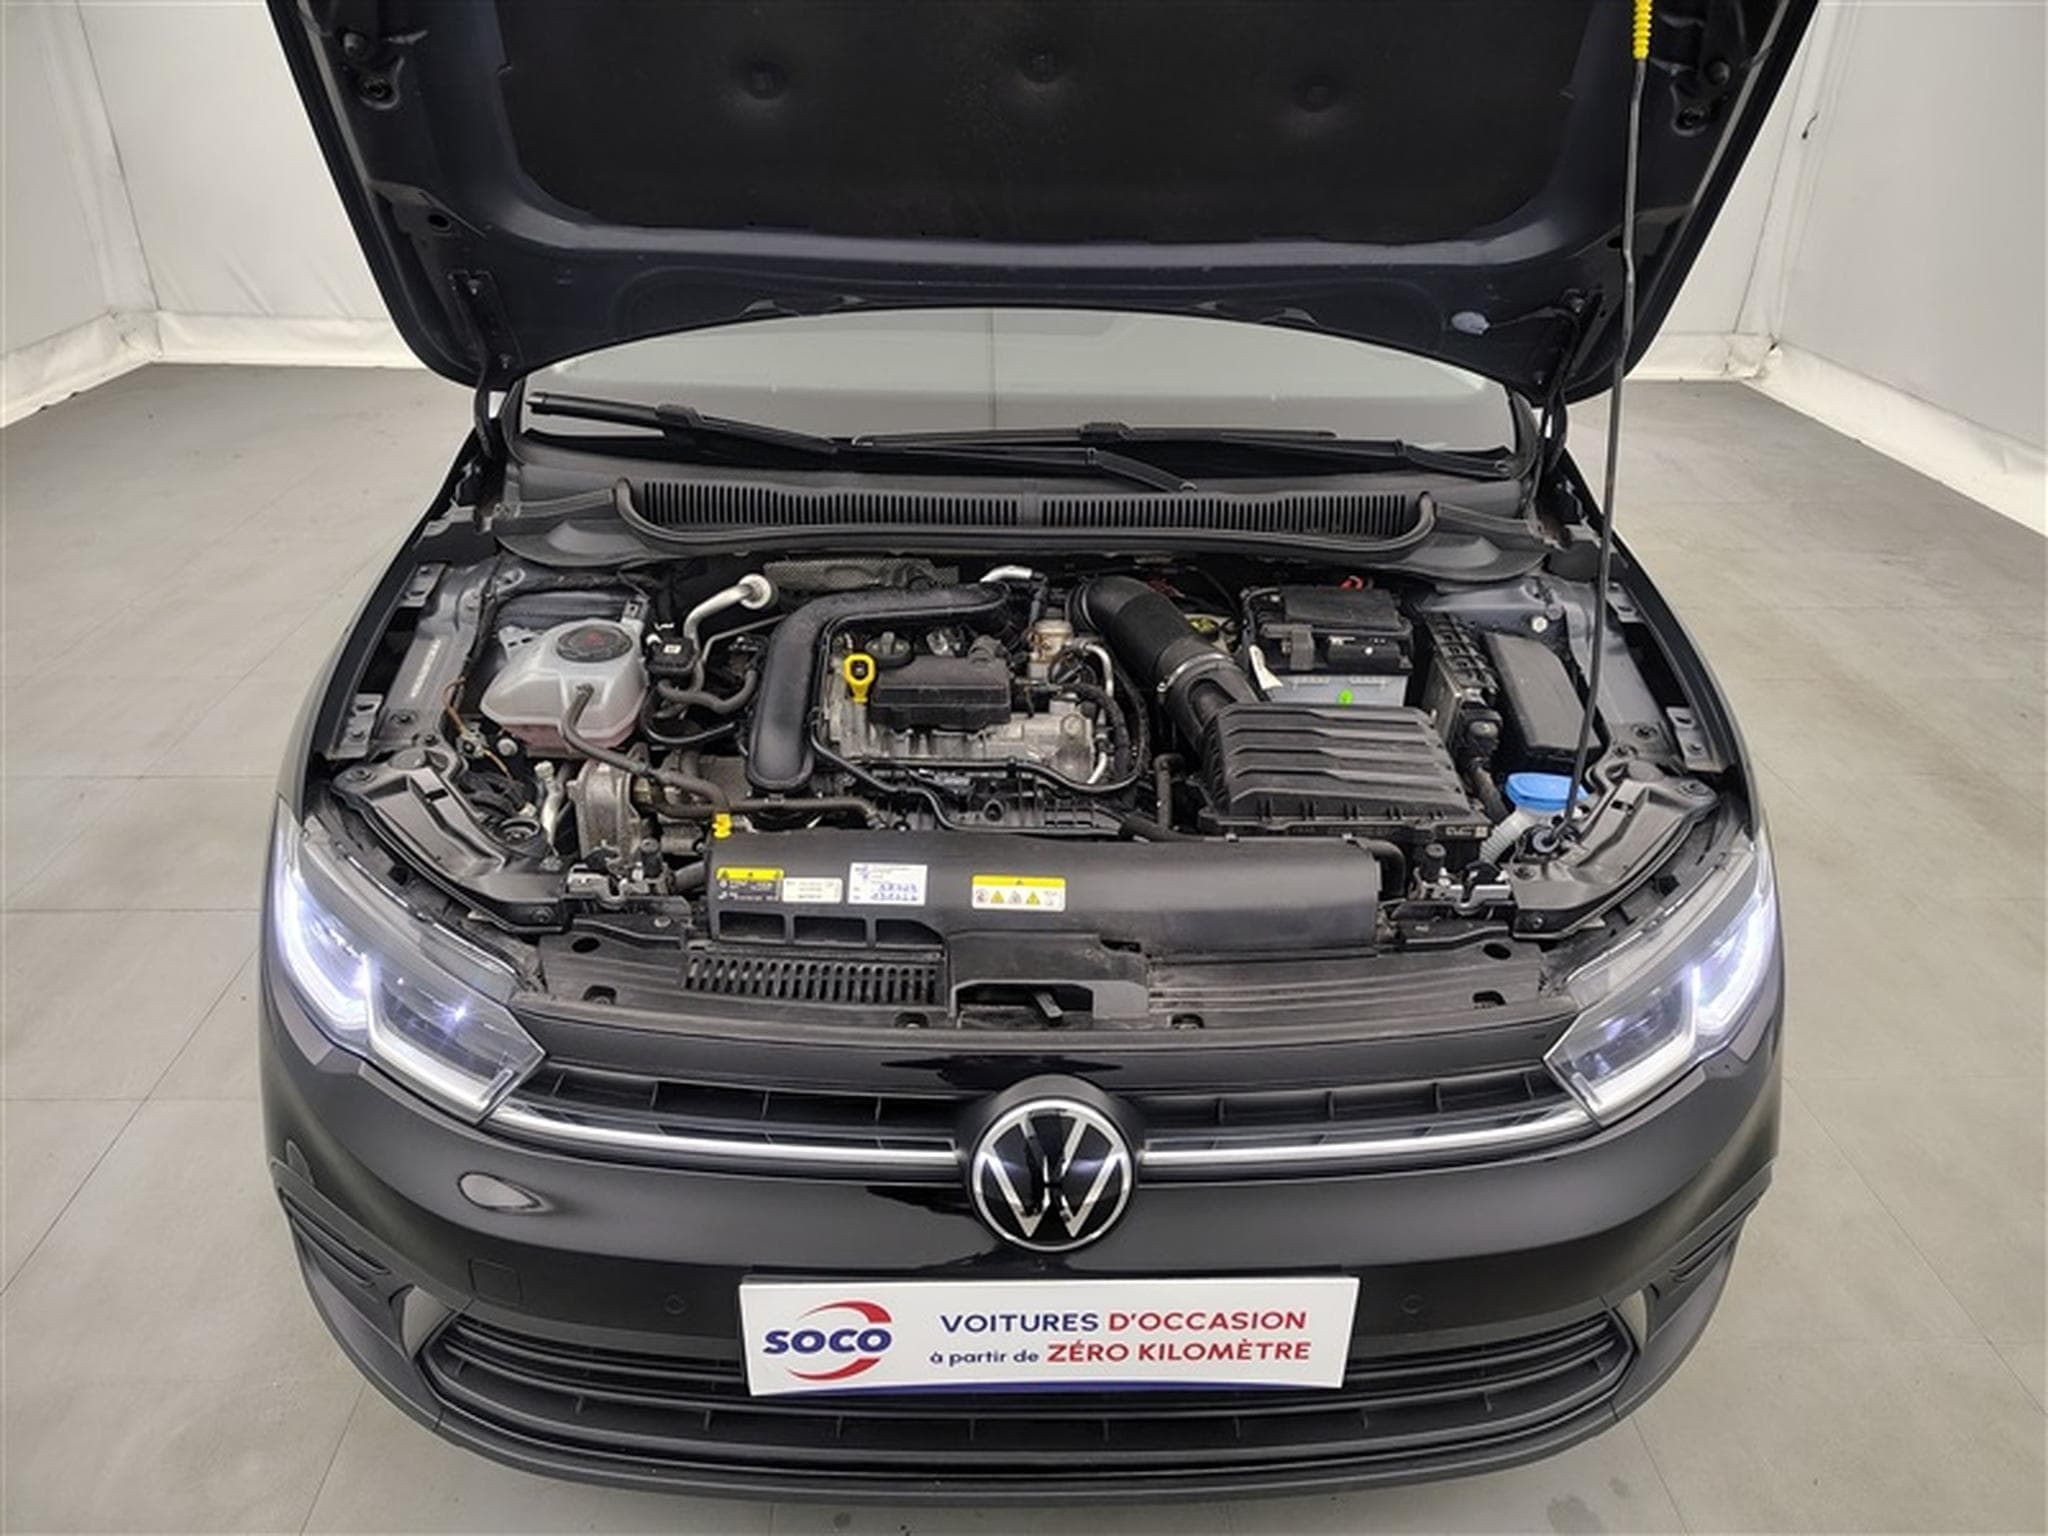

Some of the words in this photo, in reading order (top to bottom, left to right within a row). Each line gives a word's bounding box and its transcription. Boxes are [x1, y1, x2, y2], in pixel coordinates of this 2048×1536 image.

[940, 1312, 1100, 1333] VOITURES
[1109, 1310, 1308, 1332] D'OCCASION
[762, 1328, 893, 1356] SOCO
[929, 1350, 945, 1365] à
[949, 1349, 1007, 1367] partir
[1013, 1348, 1040, 1364] de
[1047, 1338, 1131, 1363] ZÉRO
[1137, 1338, 1312, 1362] KILOMÈTRE
